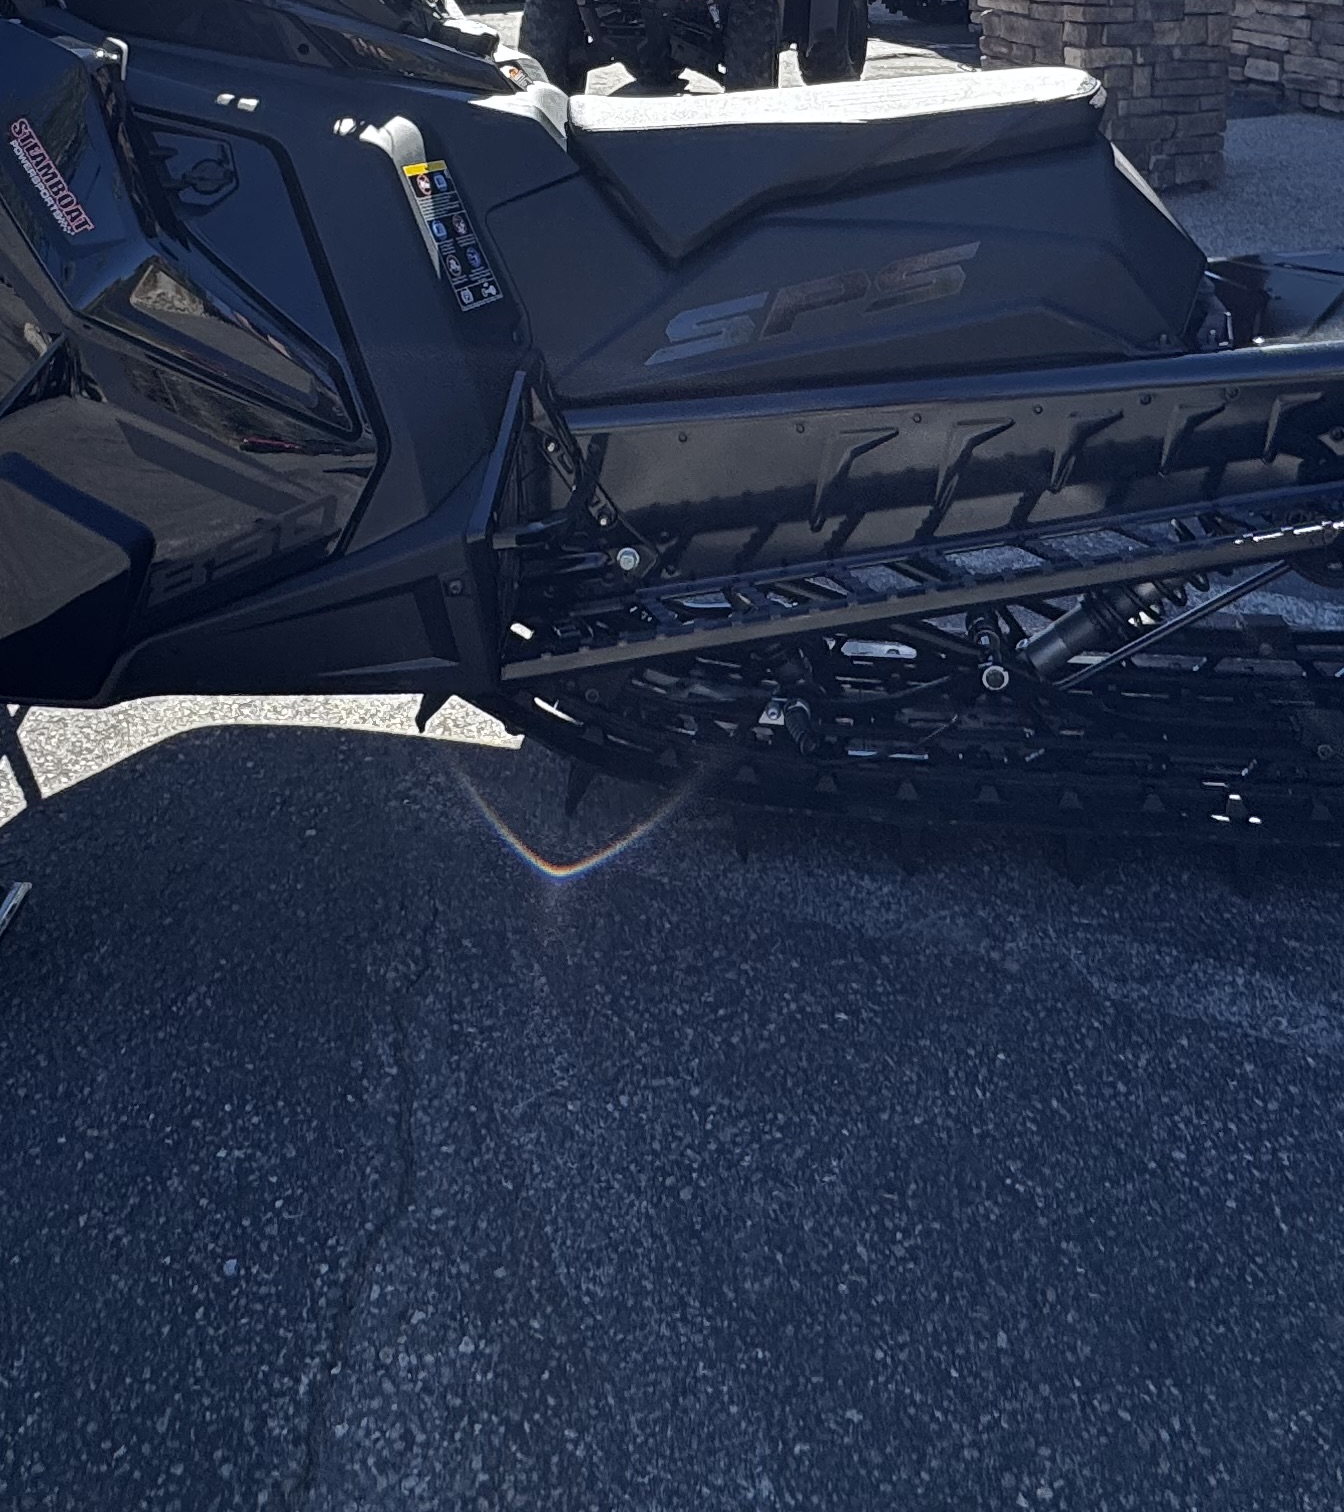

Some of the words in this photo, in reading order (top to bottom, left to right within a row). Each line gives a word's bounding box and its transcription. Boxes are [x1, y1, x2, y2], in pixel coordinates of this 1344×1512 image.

[9, 139, 64, 222] POWERSPORTS
[10, 118, 95, 233] STEAMBOAT
[644, 239, 982, 367] SPS
[146, 493, 338, 608] 850
